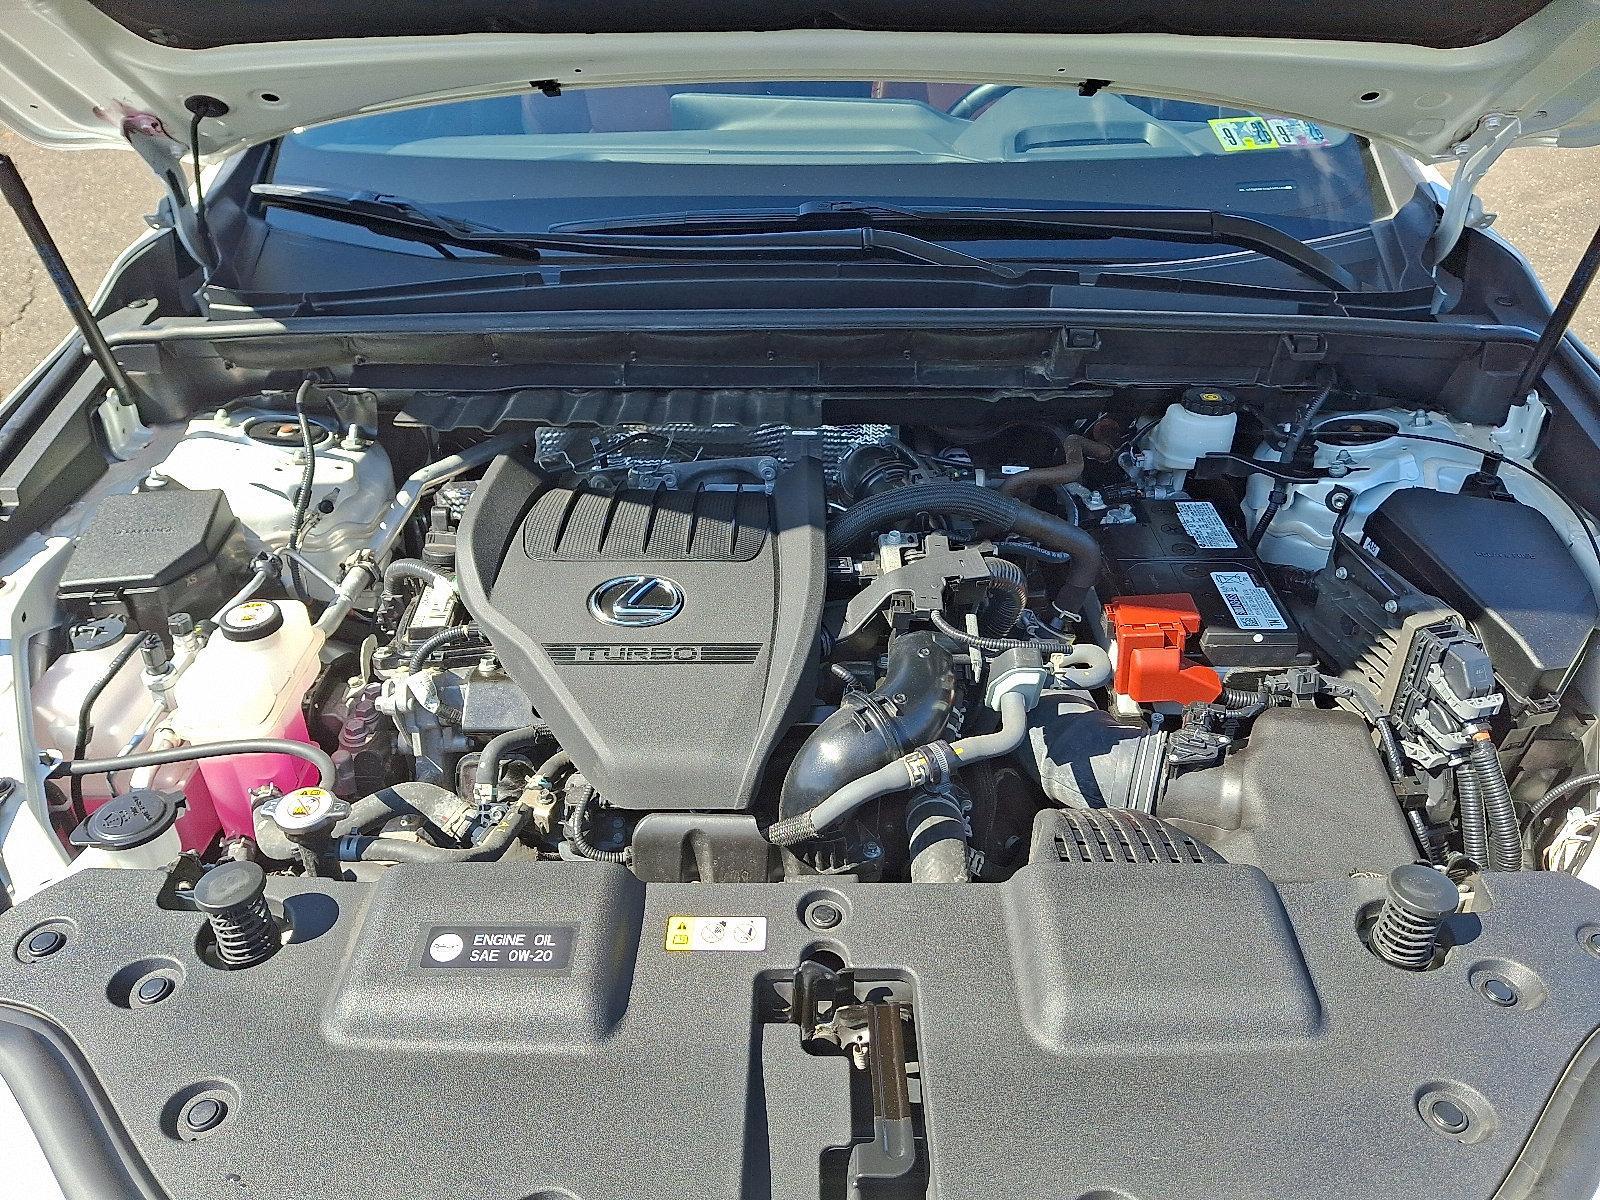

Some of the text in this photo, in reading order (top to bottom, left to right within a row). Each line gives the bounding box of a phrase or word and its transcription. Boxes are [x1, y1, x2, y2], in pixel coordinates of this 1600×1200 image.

[1222, 127, 1238, 146] 9
[1276, 125, 1292, 143] 9
[579, 646, 698, 661] TURBO
[473, 934, 556, 946] ENGINE OIL
[469, 949, 553, 962] SAE 0W-20
